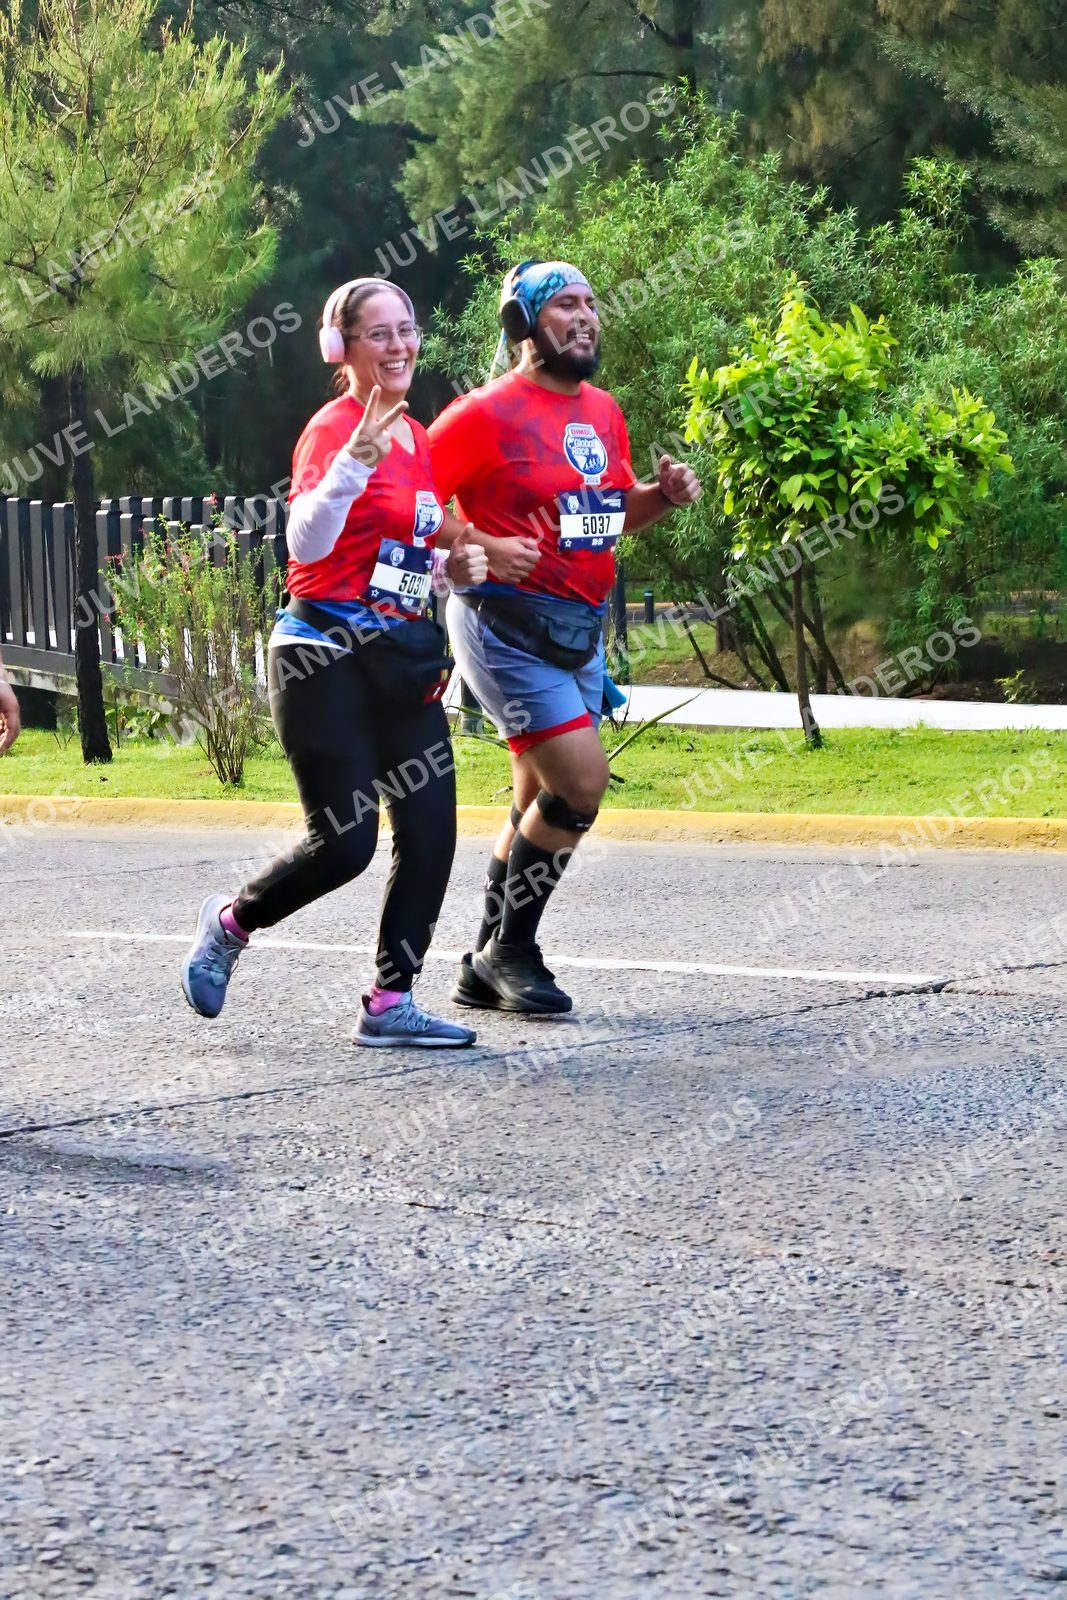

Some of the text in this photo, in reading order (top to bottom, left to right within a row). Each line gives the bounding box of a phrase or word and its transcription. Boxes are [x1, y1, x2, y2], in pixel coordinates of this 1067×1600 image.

[574, 438, 596, 448] Global
[572, 446, 590, 456] Race
[582, 515, 610, 535] 5037
